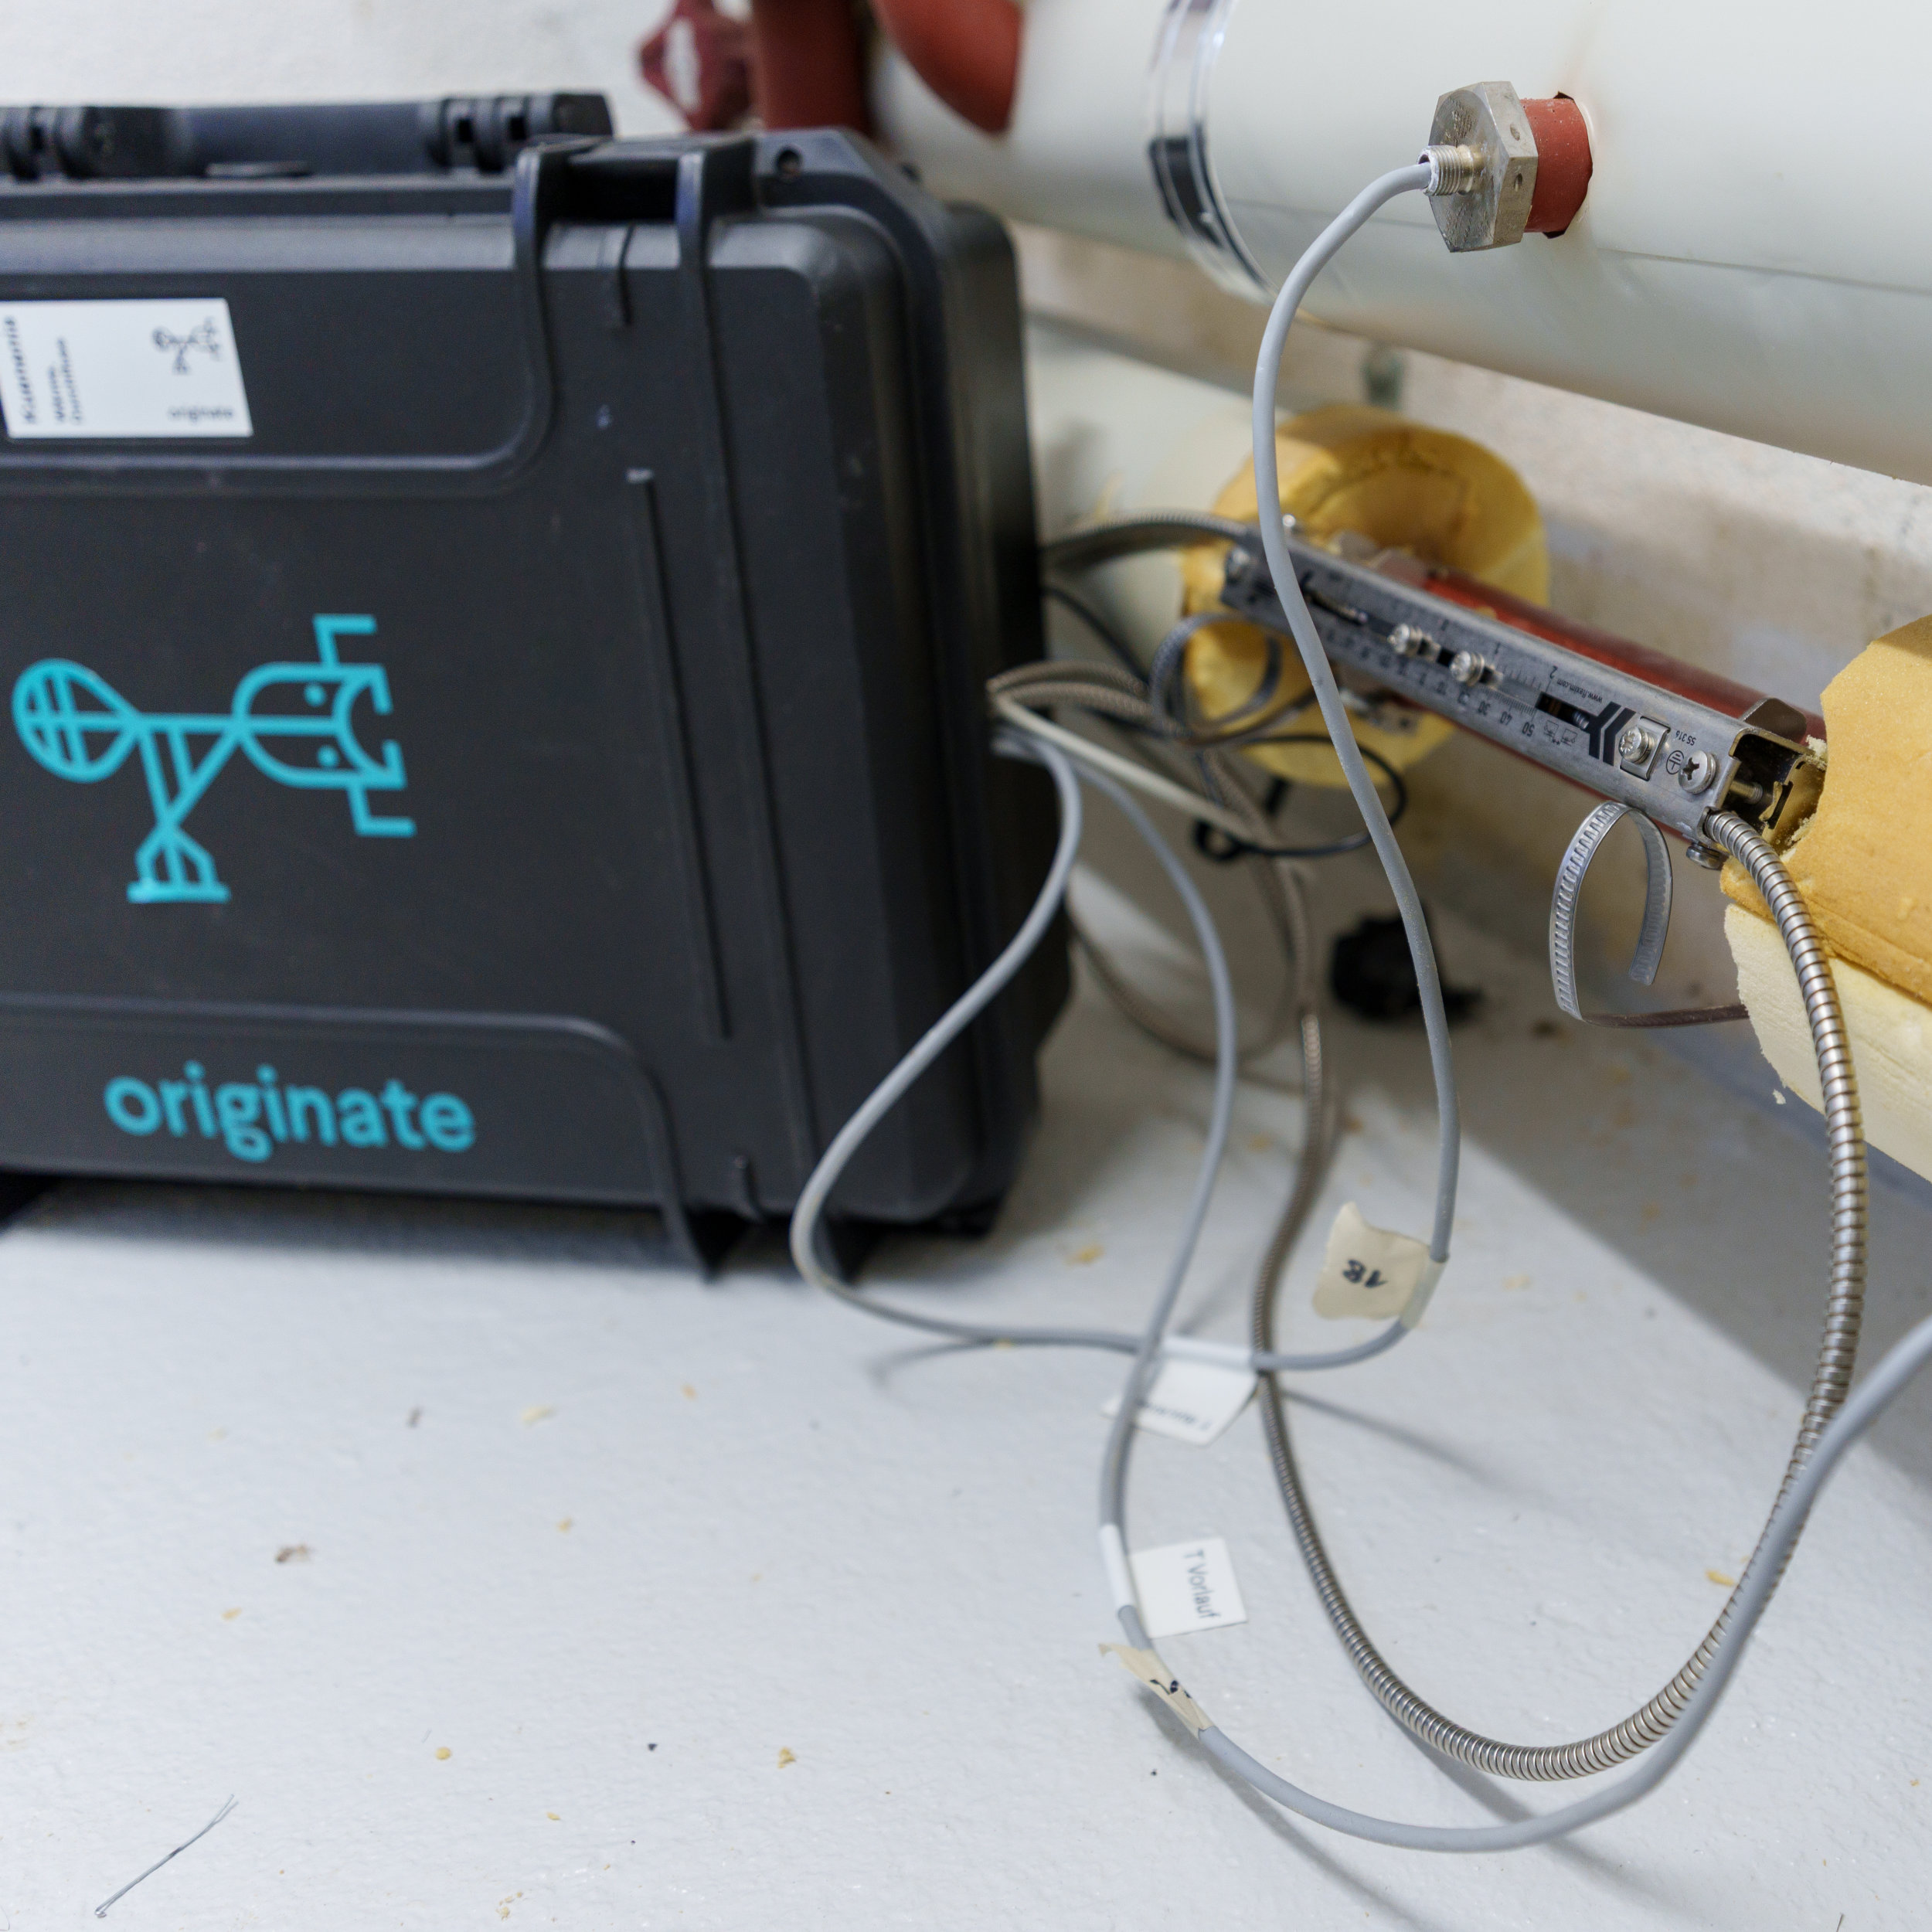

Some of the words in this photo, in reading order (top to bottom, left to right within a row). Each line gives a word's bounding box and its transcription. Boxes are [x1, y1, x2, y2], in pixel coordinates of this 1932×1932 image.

[1549, 665, 1558, 679] 2
[1557, 678, 1603, 702] www.flexim.com
[1478, 700, 1492, 716] 30
[1499, 711, 1512, 726] 40
[1522, 722, 1535, 737] 50
[1675, 730, 1686, 743] 316
[1685, 736, 1697, 747] SS
[104, 1060, 476, 1162] originate
[1183, 1549, 1205, 1560] T
[1187, 1562, 1222, 1619] Vorlauf
